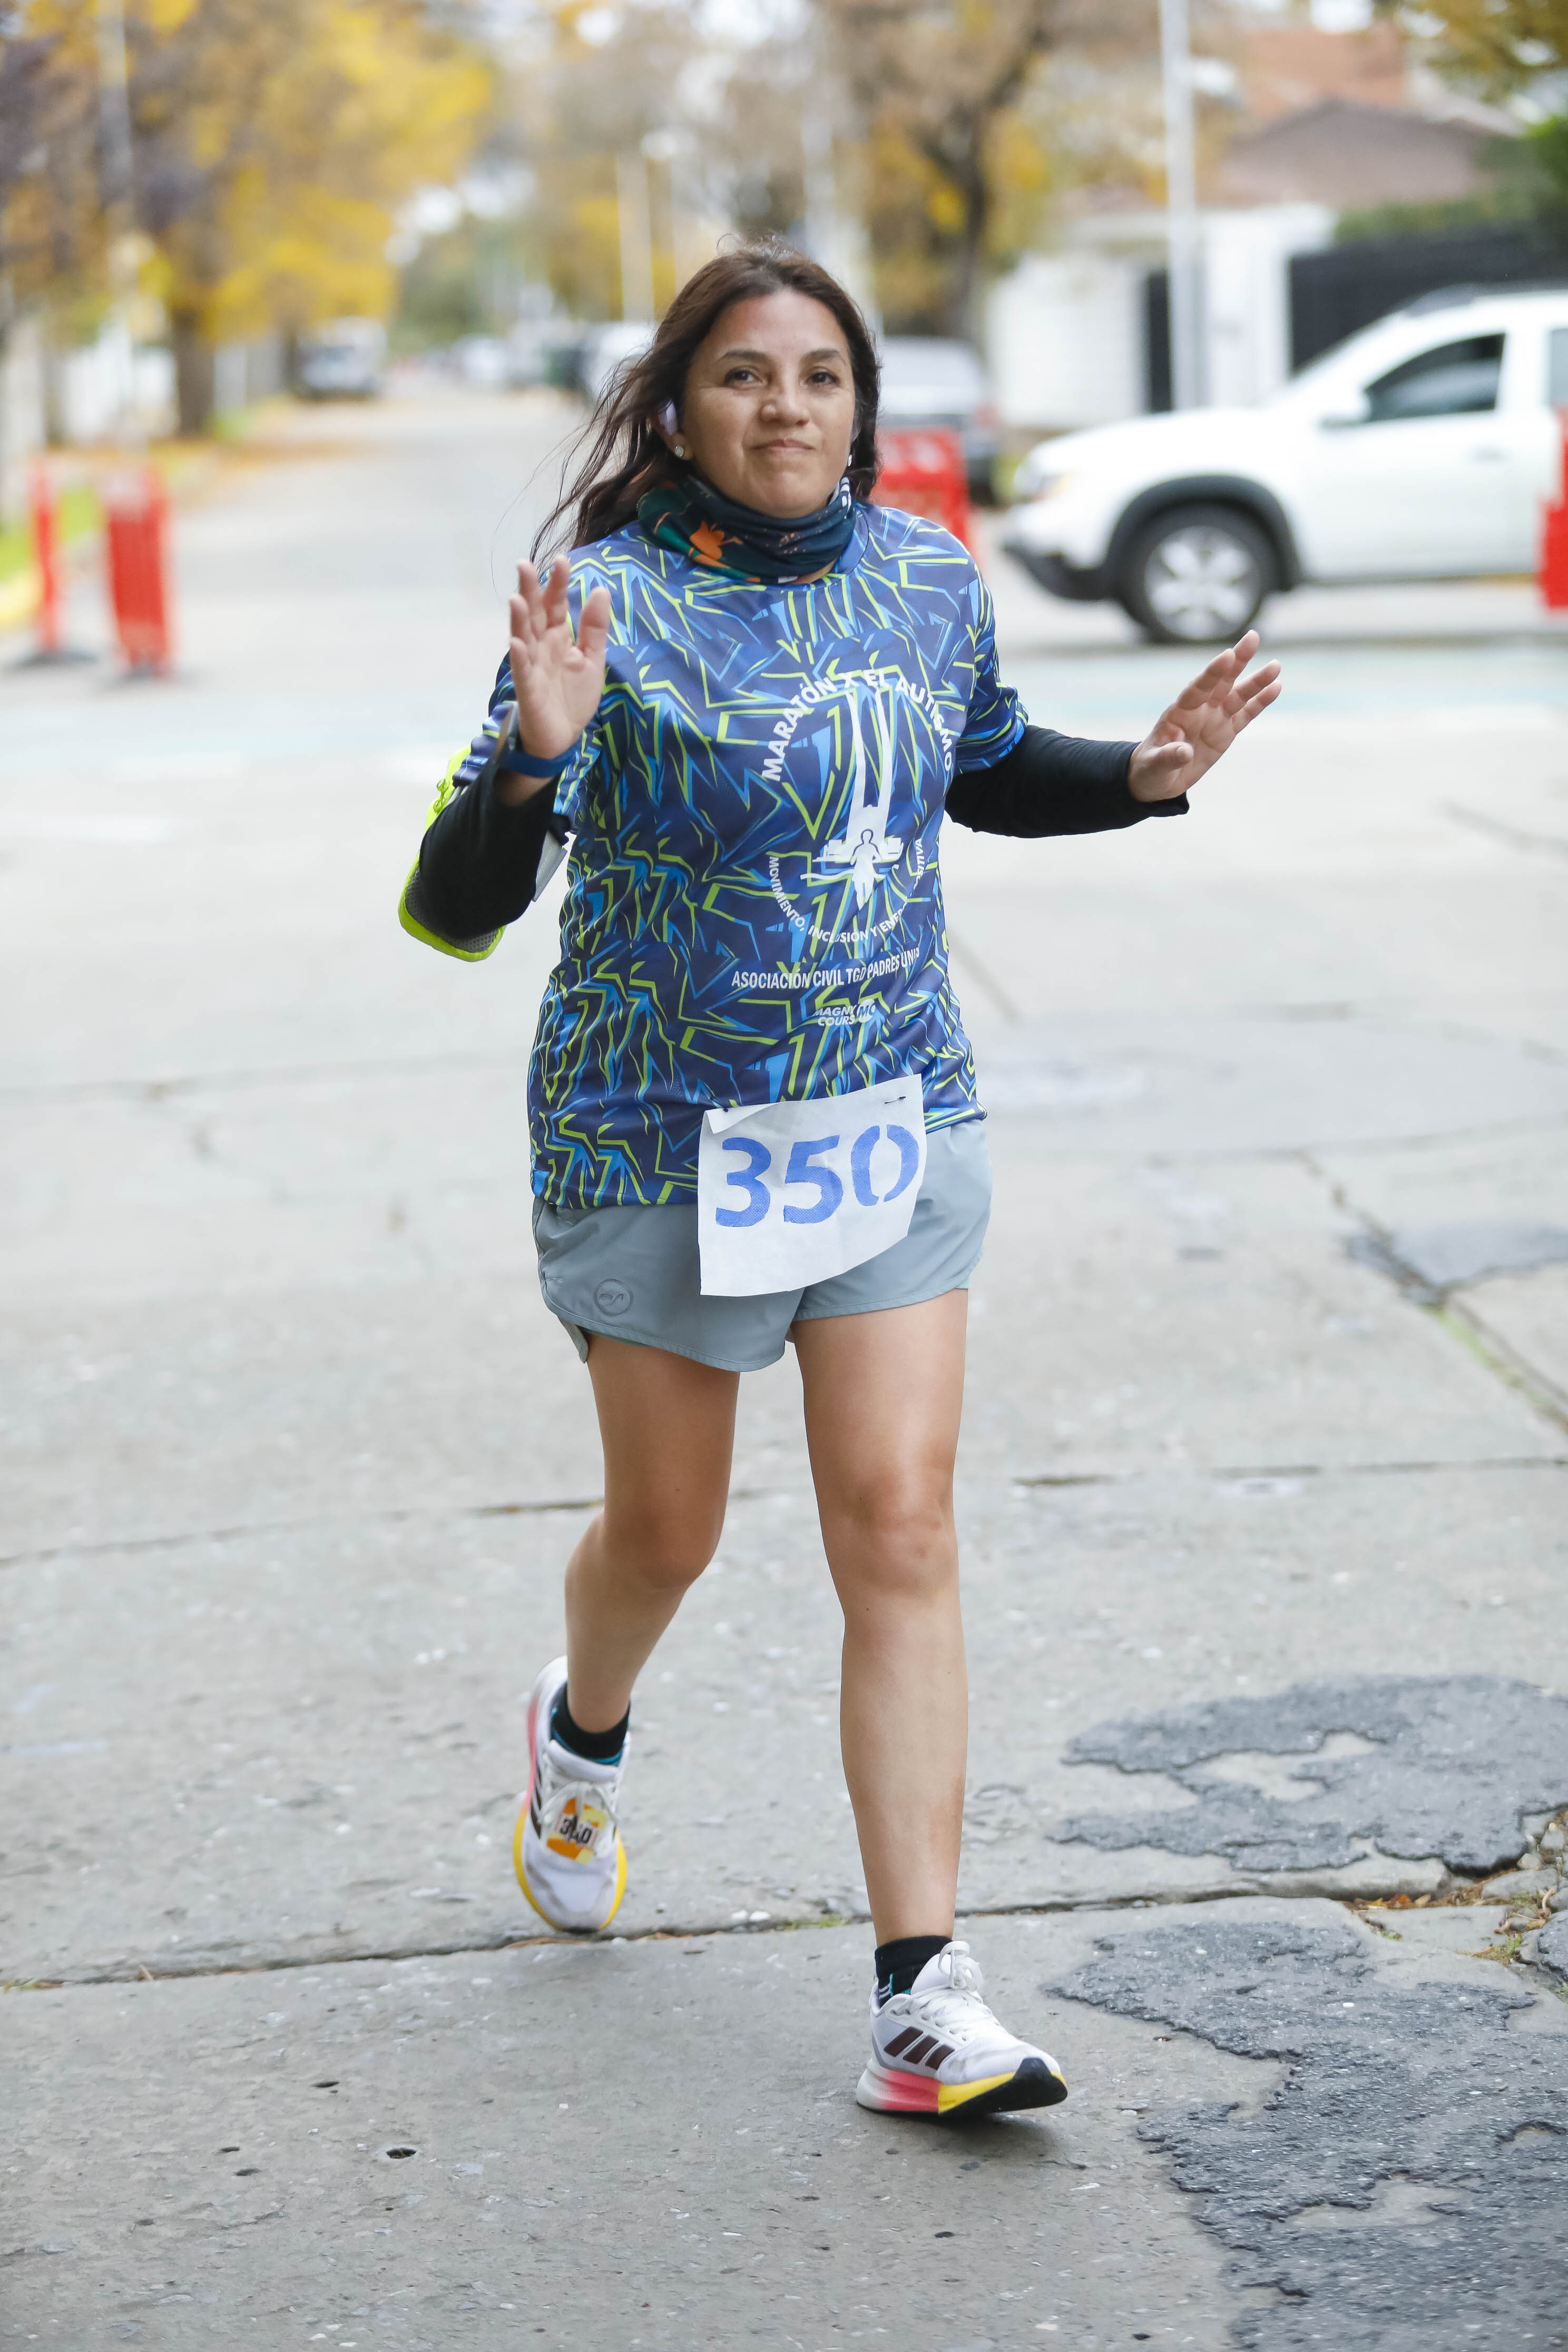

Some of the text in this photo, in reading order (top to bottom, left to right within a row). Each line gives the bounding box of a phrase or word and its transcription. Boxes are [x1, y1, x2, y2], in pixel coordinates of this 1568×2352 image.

[761, 669, 953, 782] MARATÓN X EL AUTISMO
[769, 856, 806, 932] MOVIMIENTO,
[869, 925, 877, 937] Y
[731, 968, 811, 989] ASOCIACIÓN
[812, 968, 845, 986] CIVIL
[846, 967, 867, 984] TGD
[867, 954, 900, 979] PADRES
[812, 1004, 857, 1016] MAGNY
[817, 1015, 856, 1026] COURS
[715, 1124, 919, 1227] 350
